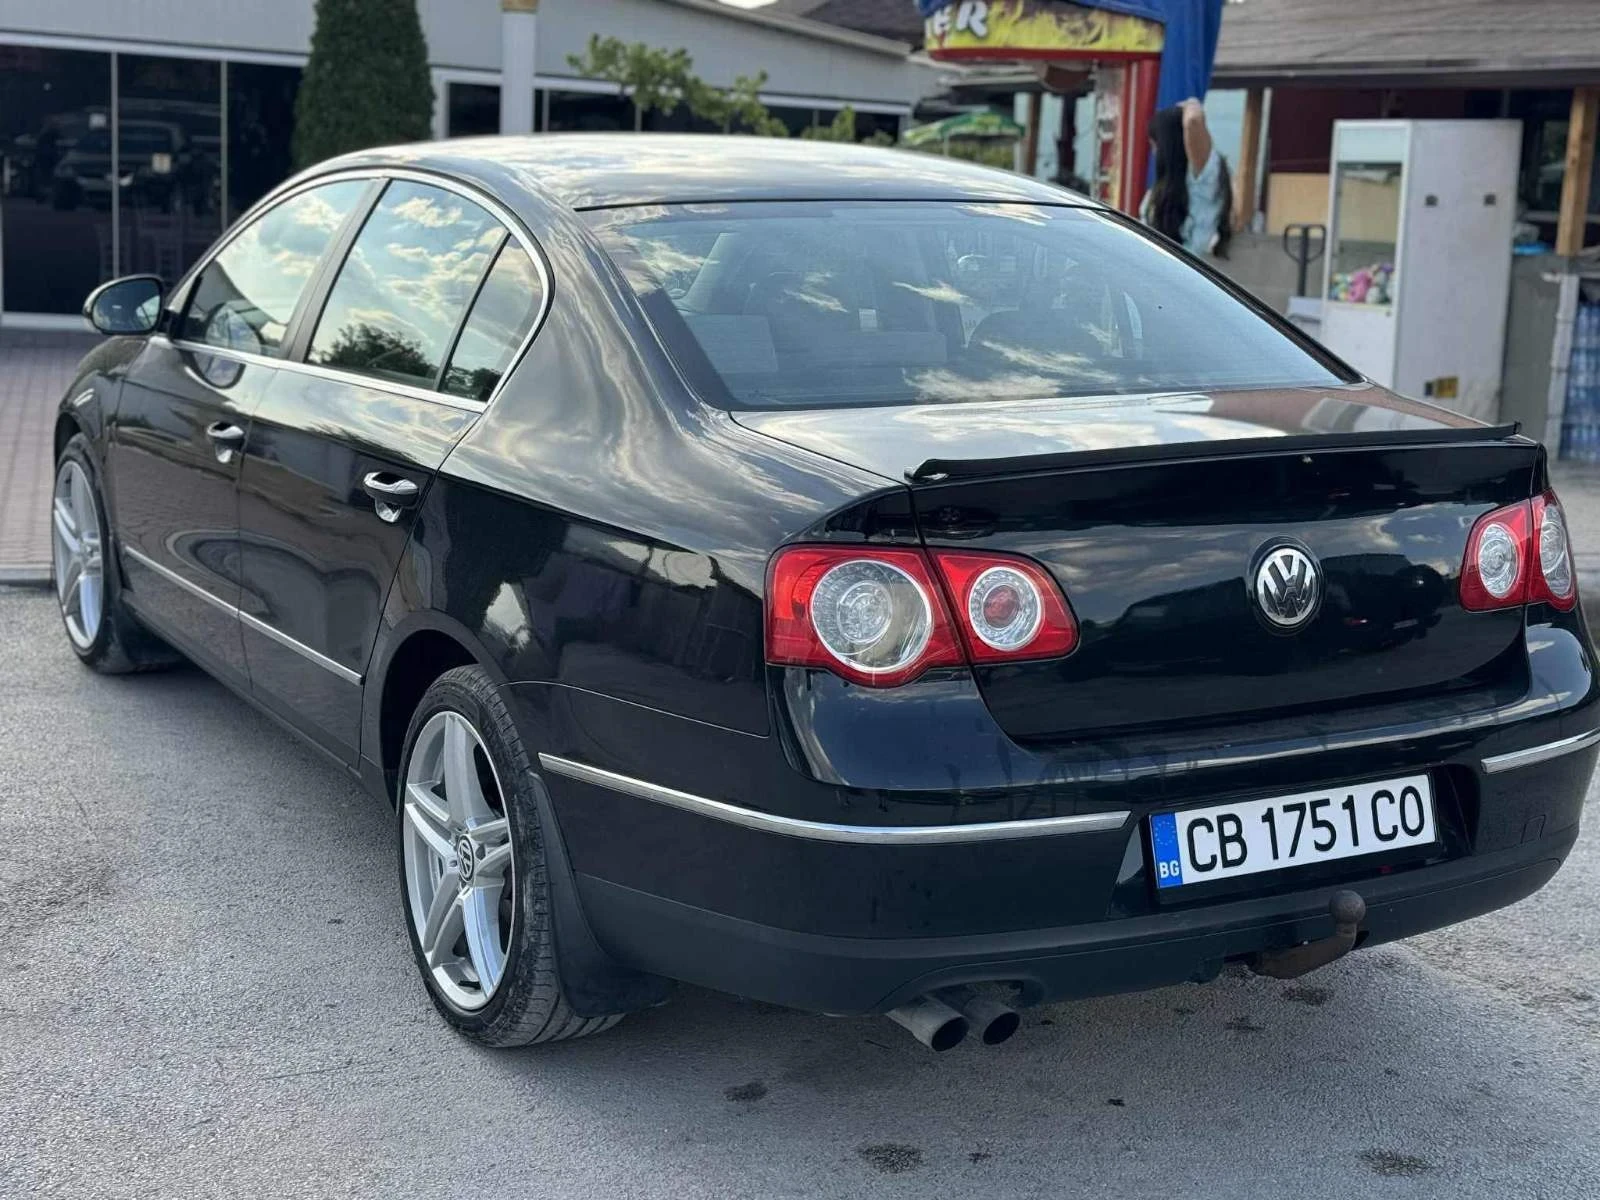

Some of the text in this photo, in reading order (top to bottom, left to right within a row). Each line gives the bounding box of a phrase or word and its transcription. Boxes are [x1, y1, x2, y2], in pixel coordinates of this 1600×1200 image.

[1257, 547, 1316, 624] VW
[1186, 785, 1425, 872] CB 1751 CO
[1159, 860, 1180, 879] BG
